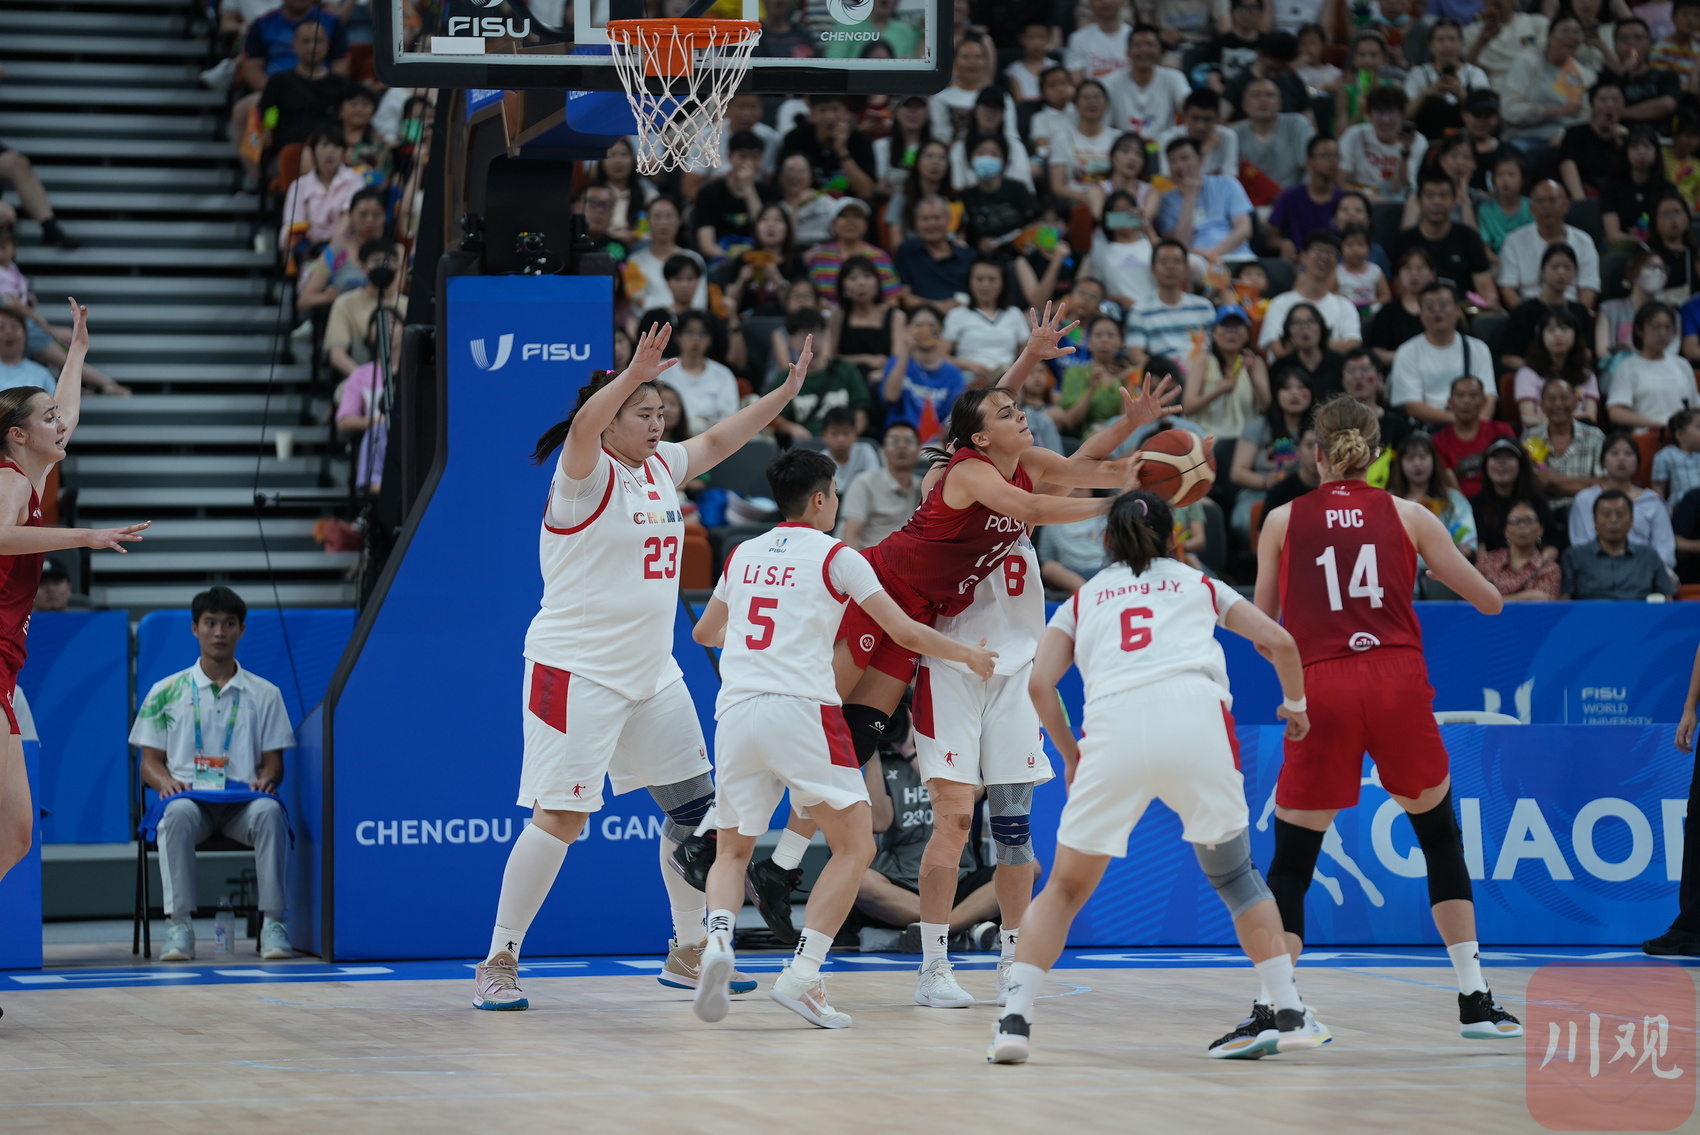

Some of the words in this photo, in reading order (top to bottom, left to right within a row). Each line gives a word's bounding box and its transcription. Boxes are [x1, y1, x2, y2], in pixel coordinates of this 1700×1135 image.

[448, 16, 530, 38] FISU
[820, 31, 880, 41] CHENGDU
[522, 343, 591, 361] FISU
[1325, 508, 1364, 529] PUC
[644, 536, 678, 579] 23
[743, 564, 761, 584] Li
[764, 566, 796, 587] S.F.
[1003, 554, 1027, 597] 8
[1315, 543, 1384, 611] 14
[1095, 582, 1150, 606] Zhang
[1157, 579, 1184, 594] J.Y.
[745, 596, 778, 650] 5
[1120, 606, 1153, 652] 6
[1581, 687, 1626, 700] FISU
[1582, 702, 1628, 714] WORLD
[355, 817, 512, 846] CHENGDU
[1371, 797, 1688, 882] QIAO
